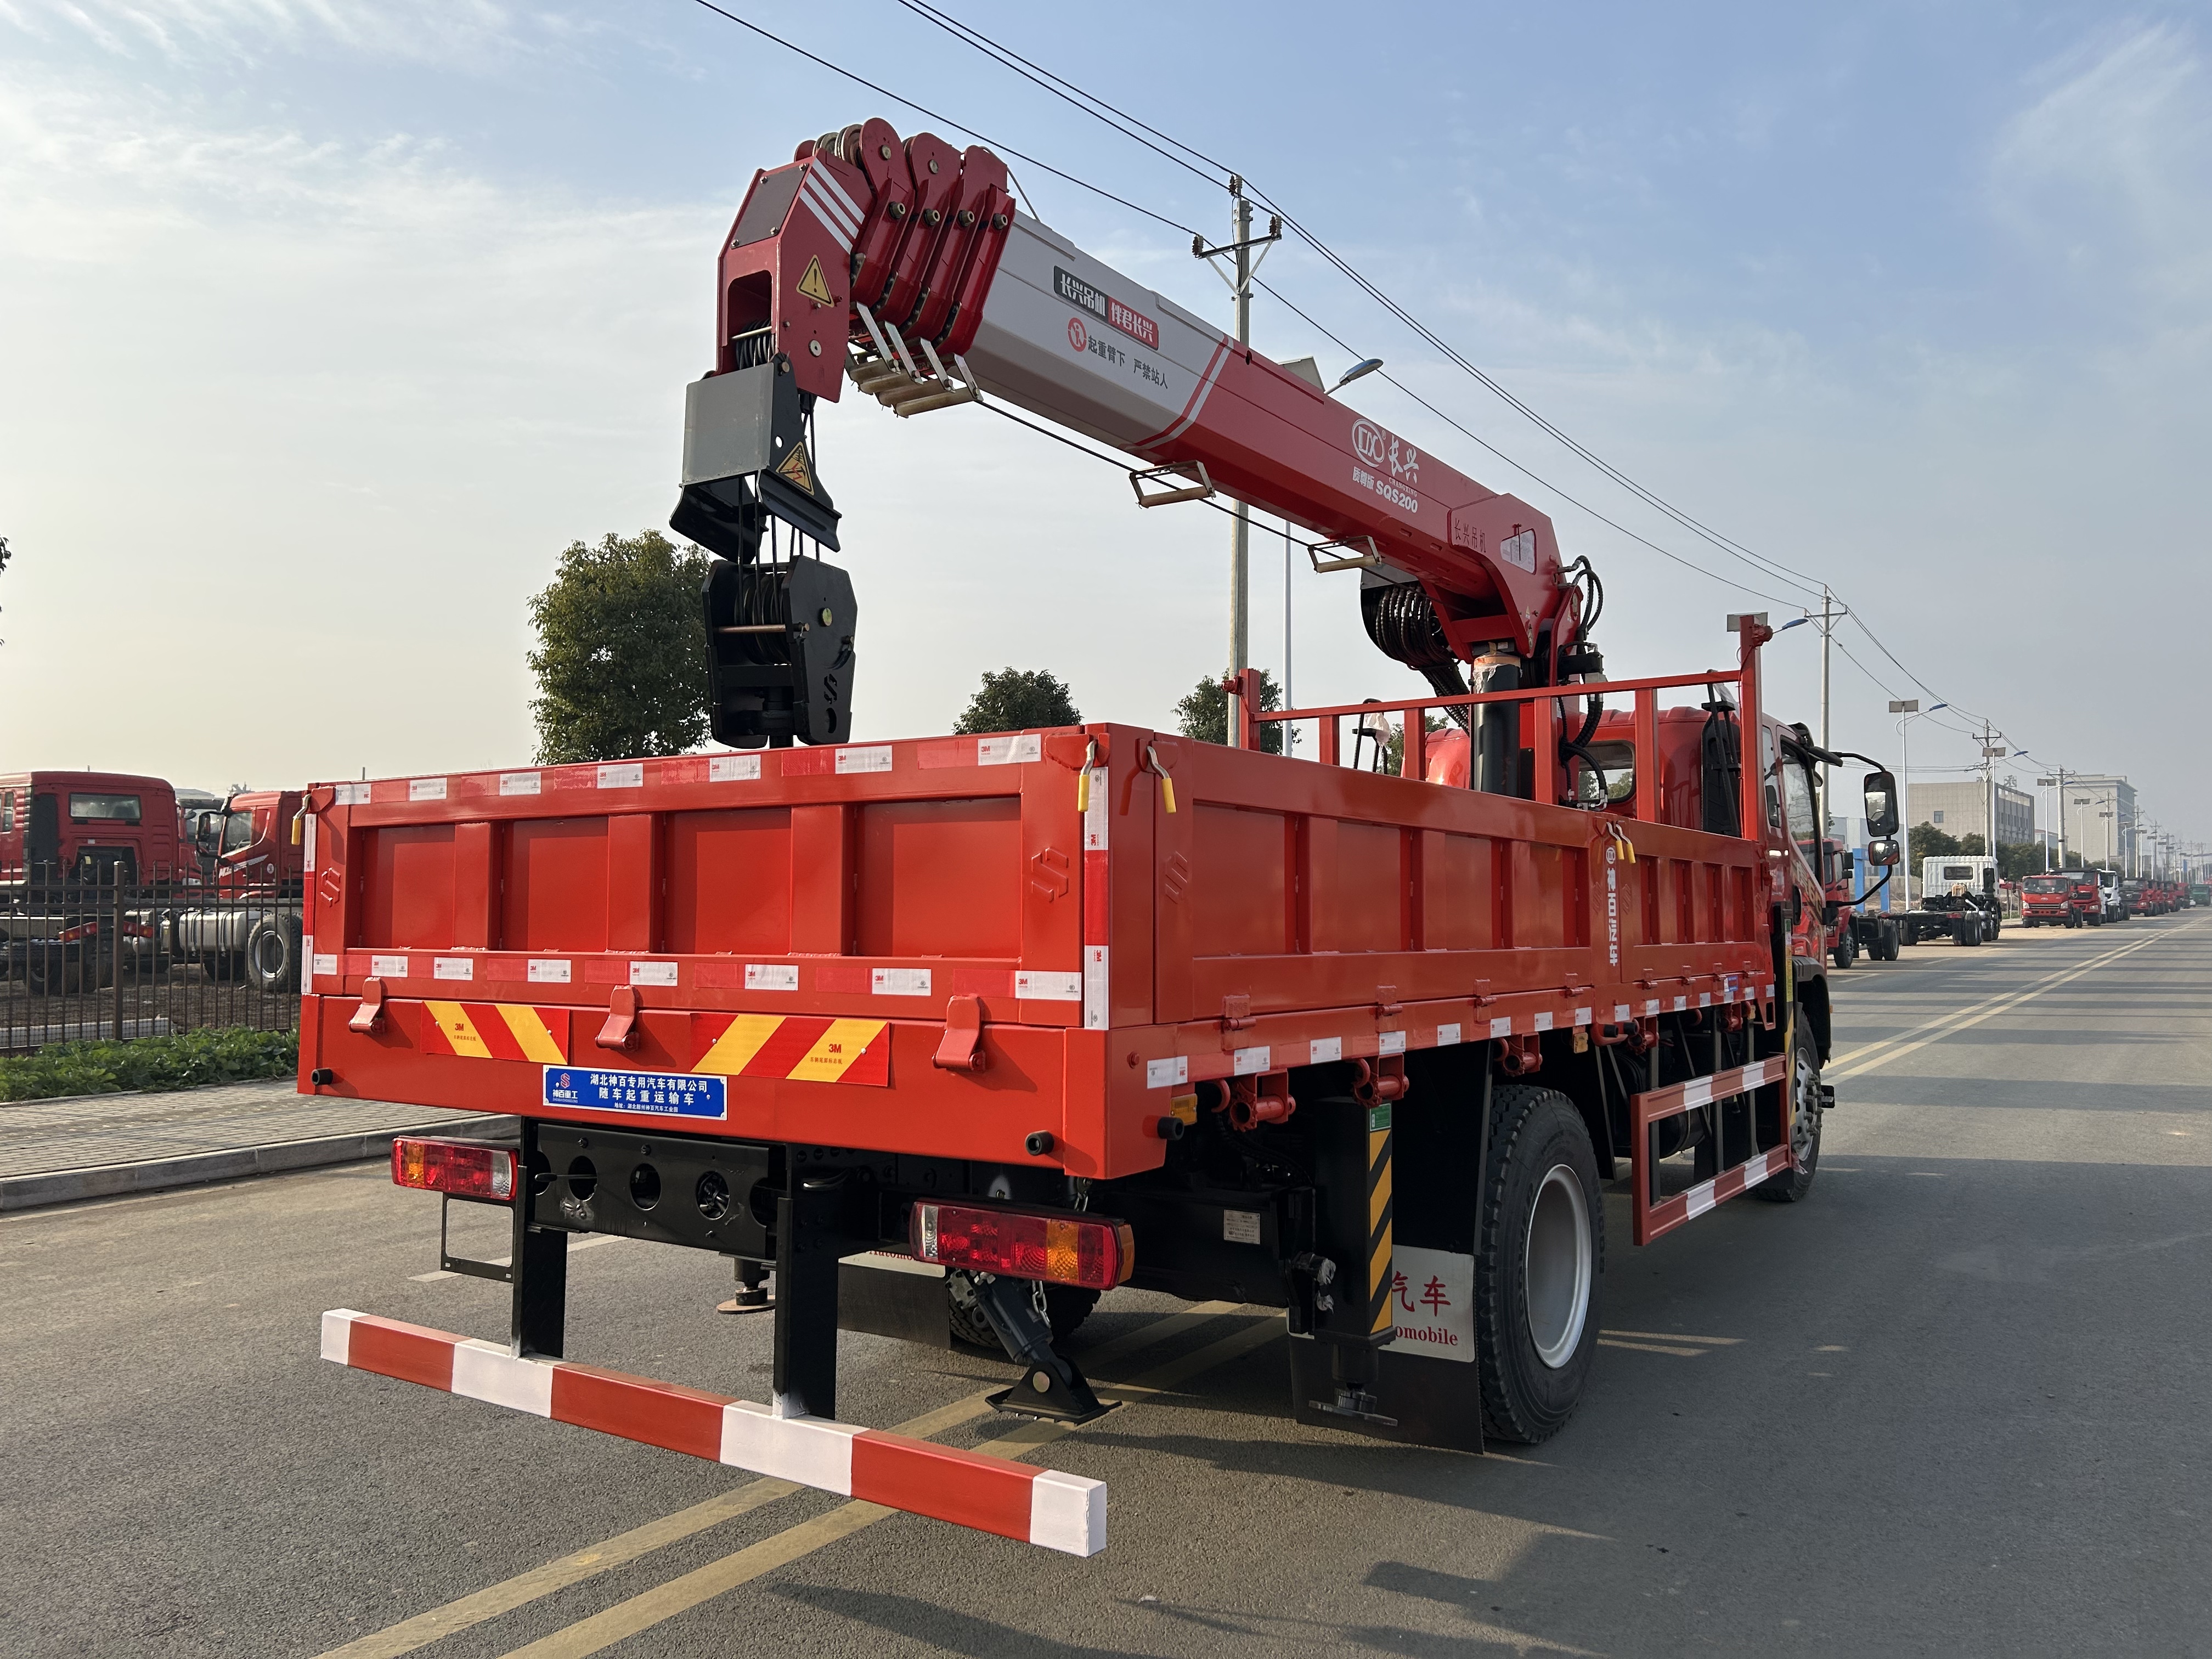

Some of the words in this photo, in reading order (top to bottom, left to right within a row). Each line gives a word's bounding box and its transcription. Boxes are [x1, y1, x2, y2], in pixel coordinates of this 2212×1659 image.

[1060, 273, 1106, 317] 长兴吊机
[1111, 302, 1153, 343] 伴君长兴
[1088, 335, 1125, 367] 起重臂下
[1133, 358, 1168, 390] 严禁站人
[1387, 434, 1420, 484] 长兴
[1375, 480, 1418, 514] SQS200
[1389, 477, 1418, 497] CHANGXING
[1454, 517, 1486, 554] 长兴吊机
[1090, 834, 1096, 846] 3M
[1096, 949, 1102, 962] 3M
[454, 1023, 464, 1031] 3M
[828, 1043, 842, 1053] 3M
[590, 1073, 708, 1093] 湖北神百专用汽车有限公司
[599, 1087, 695, 1105] 随车起重运输车
[1396, 1325, 1458, 1346] omobile
